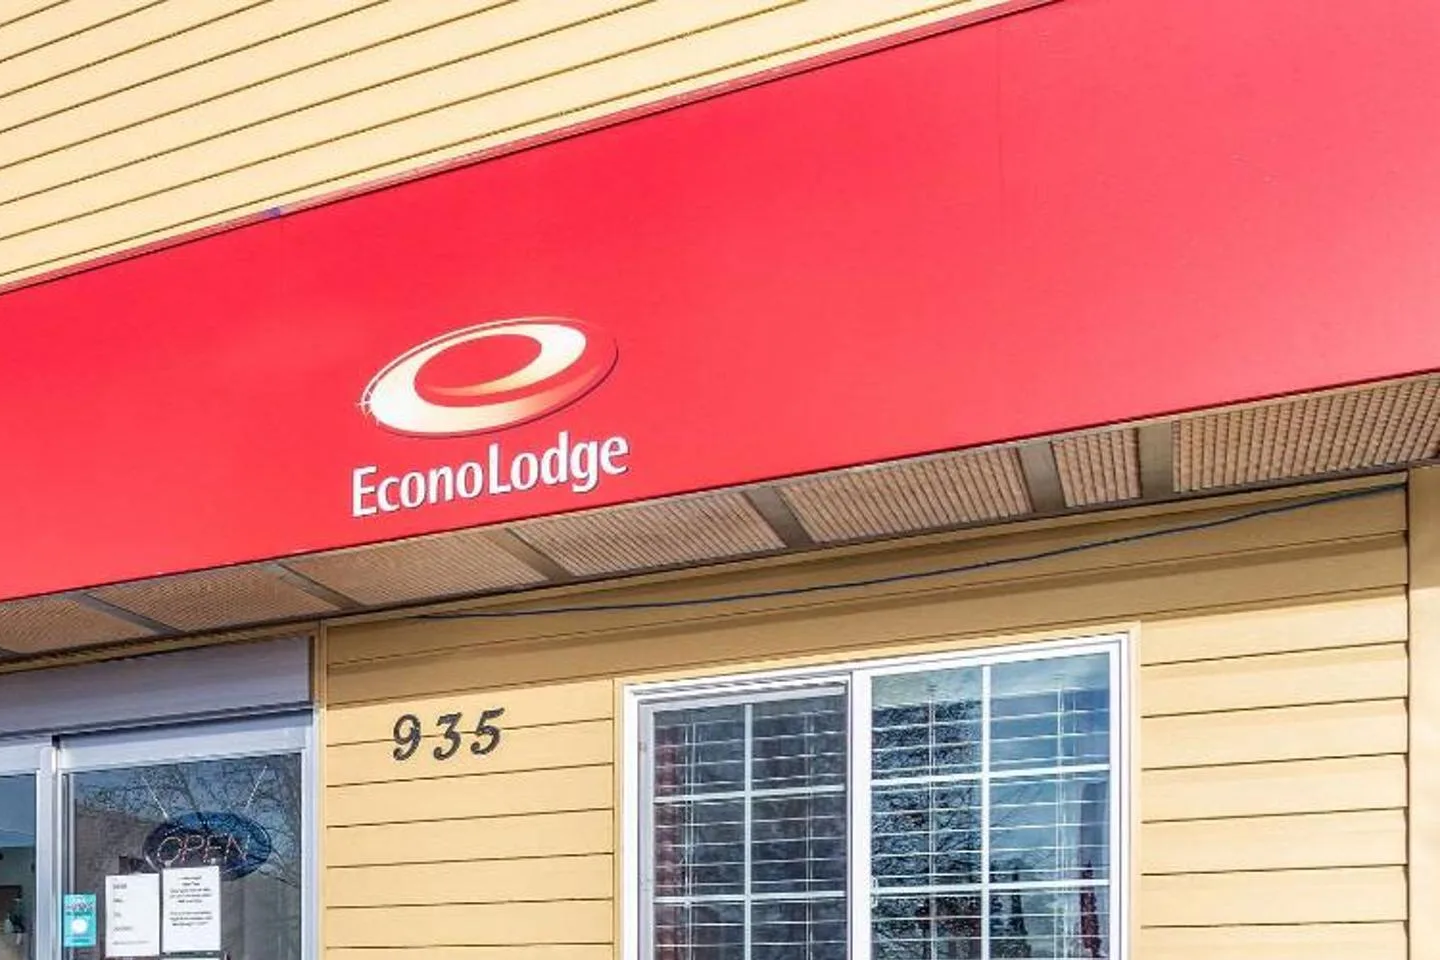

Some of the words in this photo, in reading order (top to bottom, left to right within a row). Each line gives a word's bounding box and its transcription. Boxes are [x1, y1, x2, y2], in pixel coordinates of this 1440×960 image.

[351, 431, 629, 517] EconoLodge
[393, 707, 504, 760] 935
[156, 832, 250, 865] OPEN
